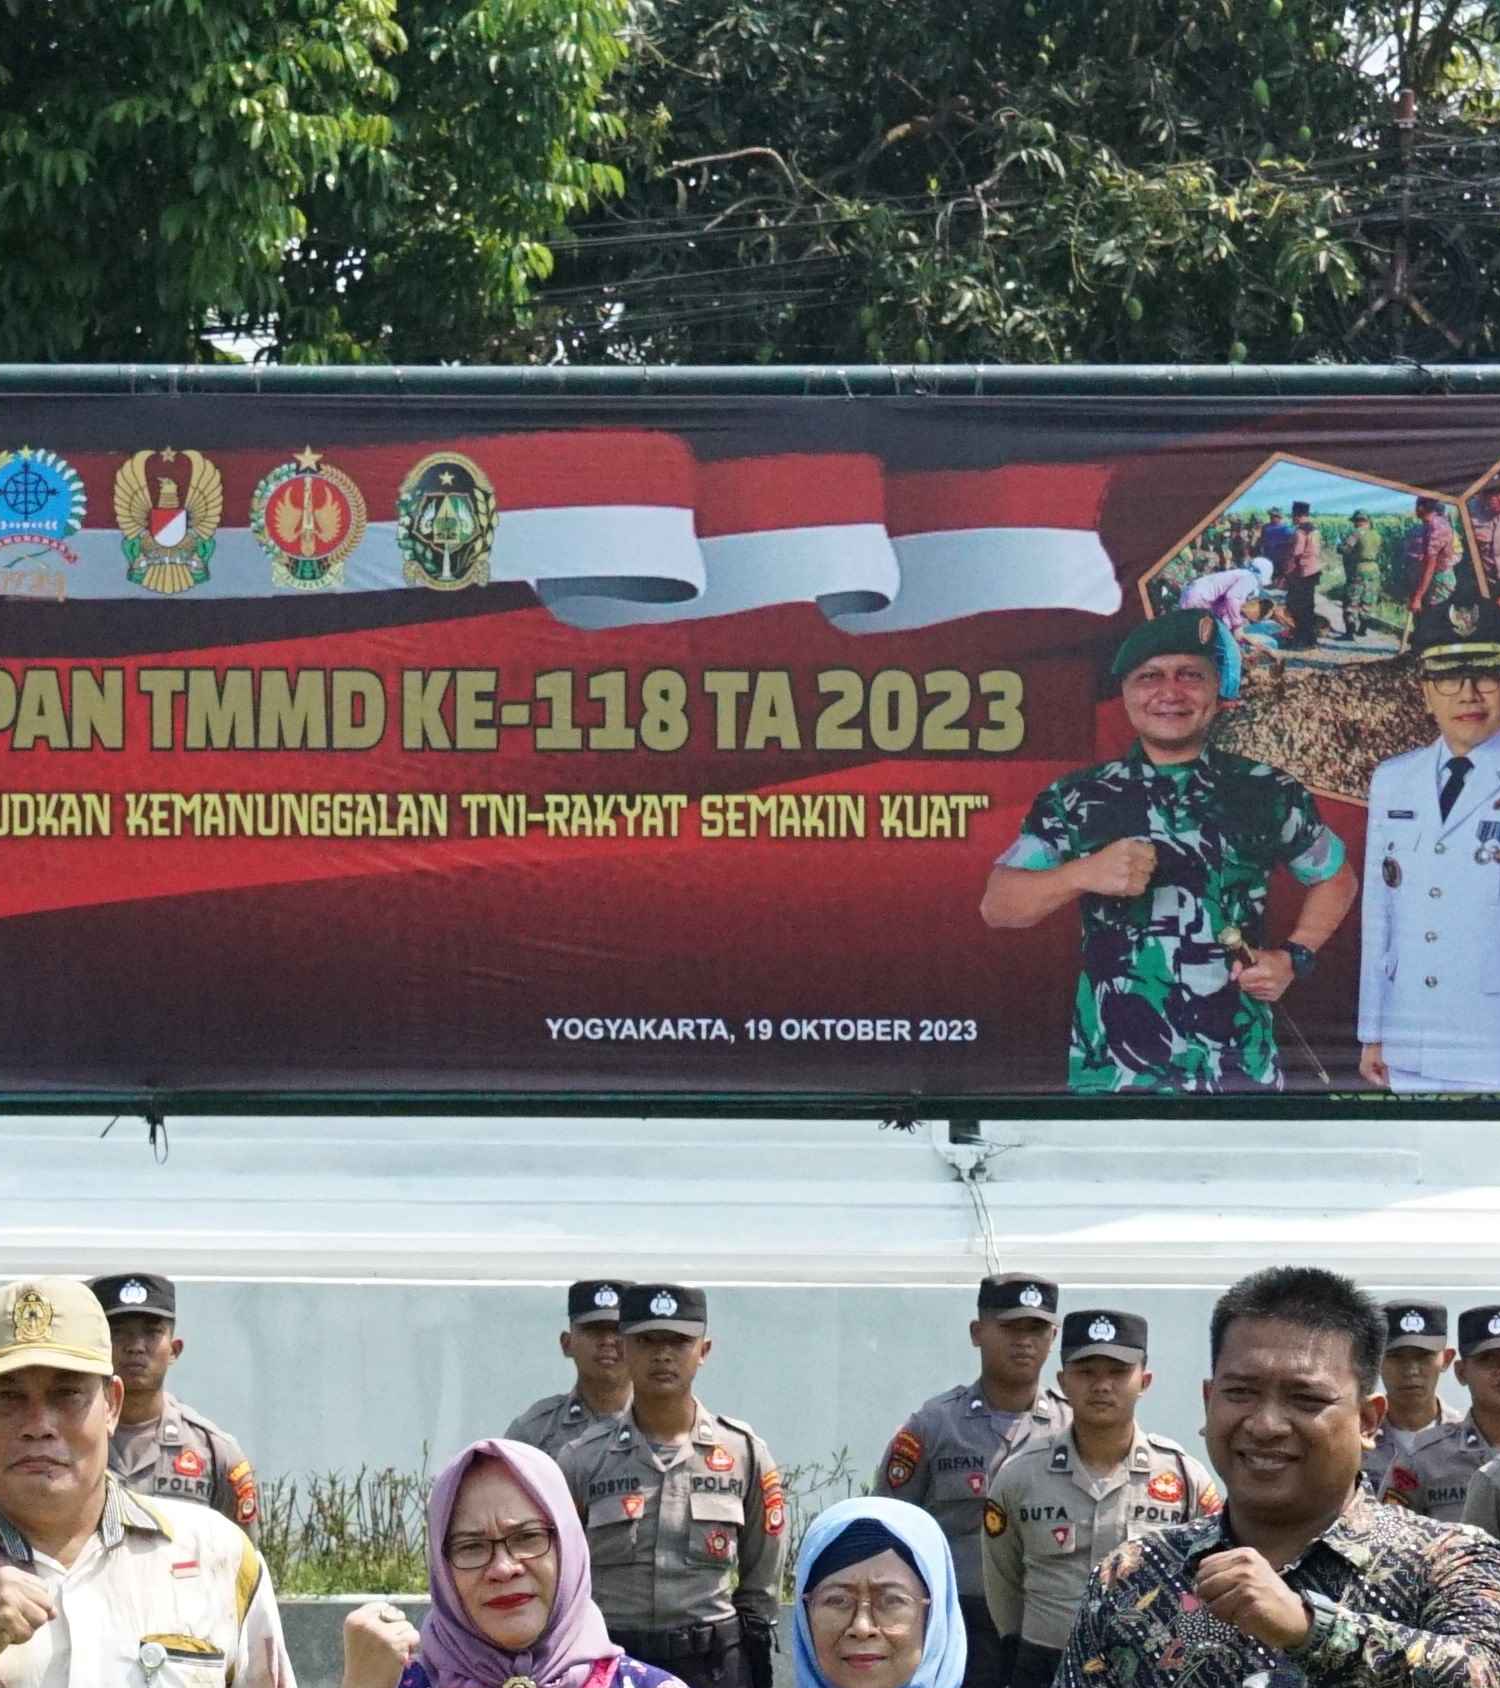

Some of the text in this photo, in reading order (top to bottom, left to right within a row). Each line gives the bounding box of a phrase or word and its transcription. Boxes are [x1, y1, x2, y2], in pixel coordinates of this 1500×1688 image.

[138, 668, 386, 750] TMMD
[402, 669, 690, 753] KE-118
[702, 670, 802, 751] TA
[814, 669, 1026, 753] 2023
[125, 793, 448, 837] KEMANUNGGALAN
[460, 793, 688, 837] TNI-RAKYAT
[700, 794, 865, 838] SEMAKIN
[545, 1017, 978, 1044] YOGYAKARTA, 19 OKTOBER 2023
[937, 1455, 986, 1472] IRFAN
[156, 1476, 214, 1497] POLRI
[692, 1476, 743, 1495] POLRI
[1019, 1506, 1069, 1523] DUTA
